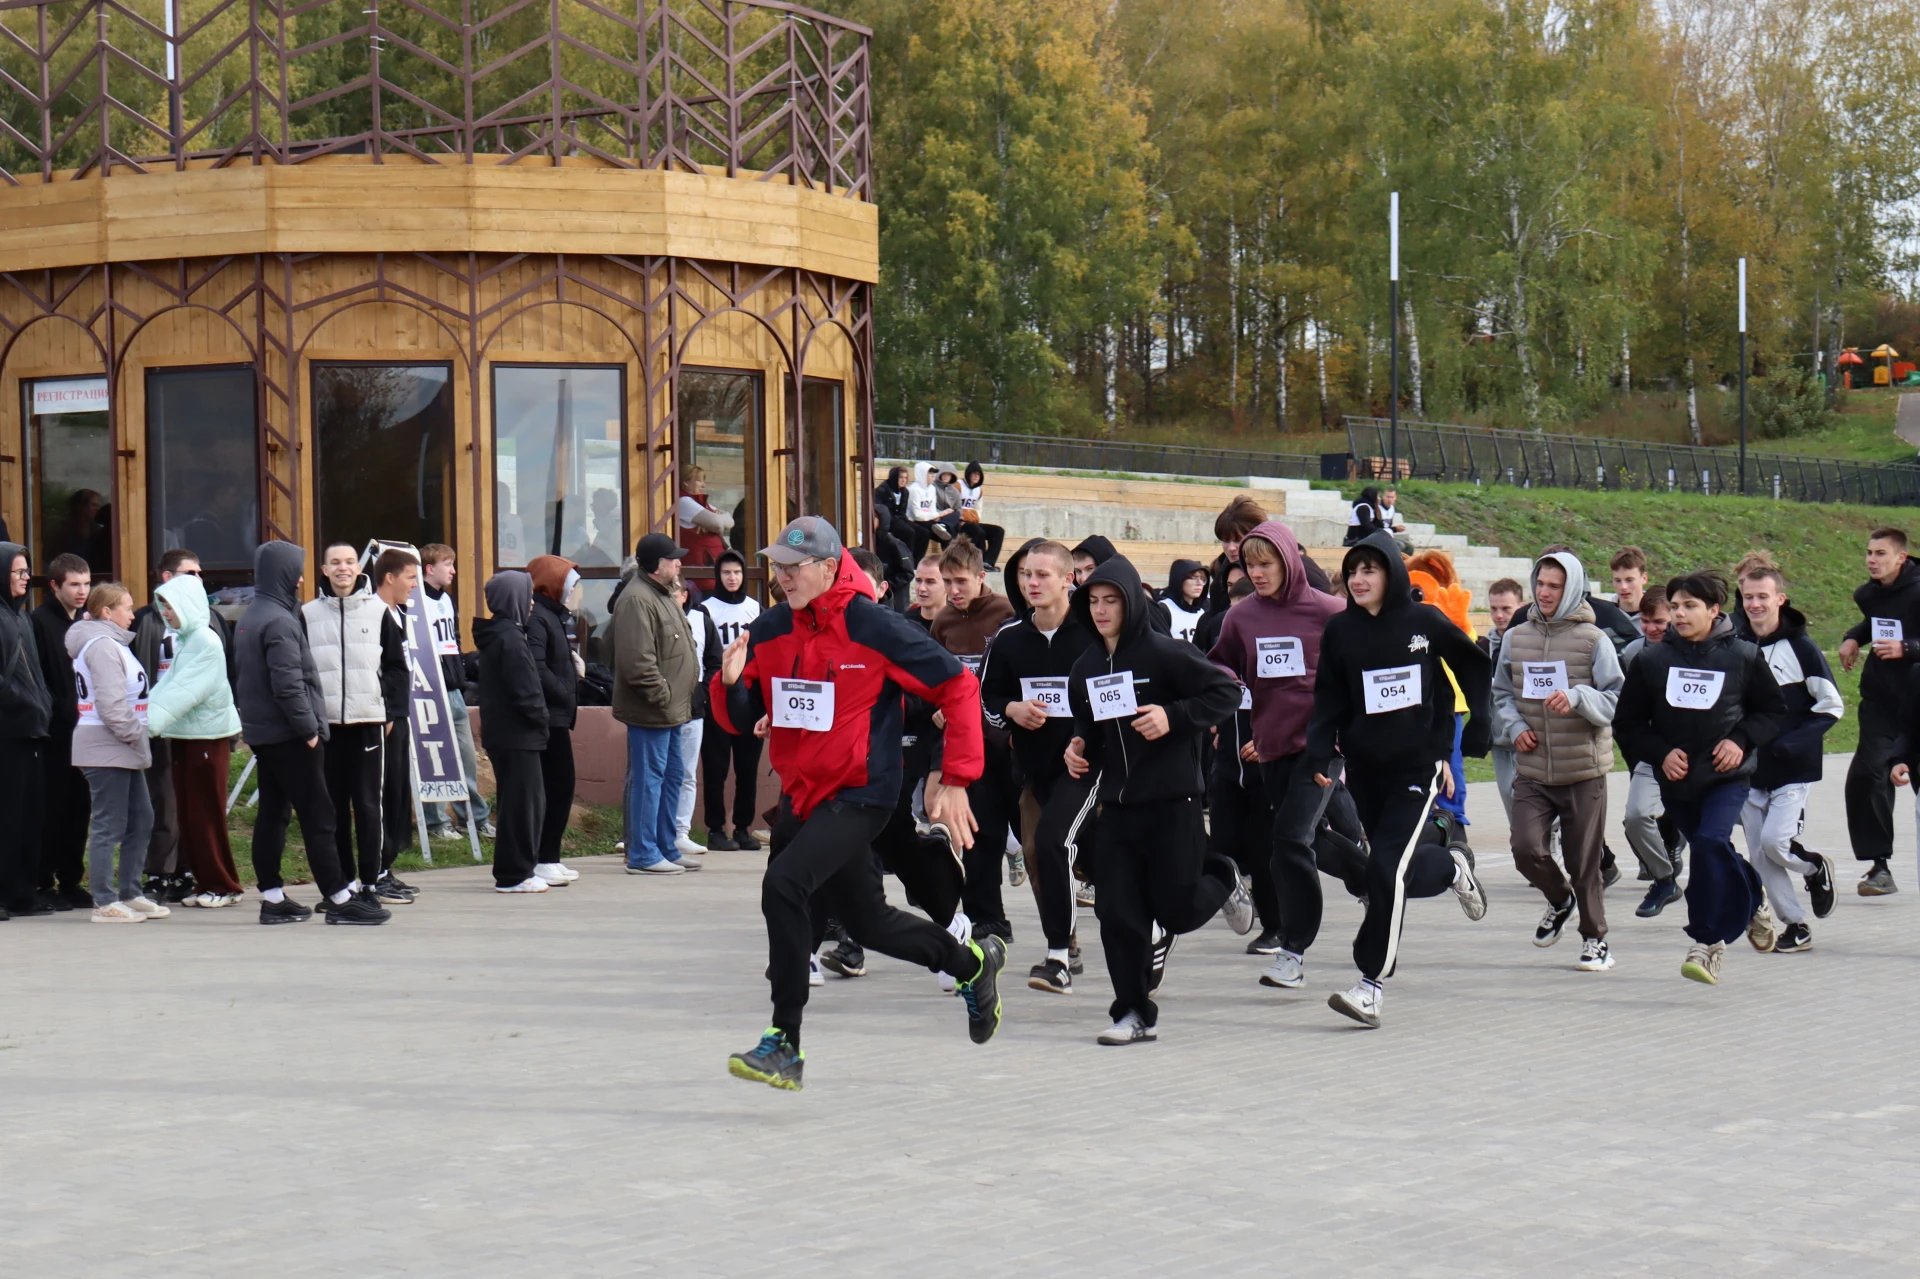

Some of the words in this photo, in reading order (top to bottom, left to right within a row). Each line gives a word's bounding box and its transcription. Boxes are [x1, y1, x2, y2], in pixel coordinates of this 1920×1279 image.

[433, 617, 455, 642] 170
[1880, 629, 1894, 637] 098
[1265, 653, 1289, 664] 067
[406, 599, 446, 776] ТАРТ
[1533, 678, 1553, 687] 056
[1682, 683, 1707, 694] 076
[1100, 689, 1121, 703] 065
[1380, 685, 1406, 698] 054
[788, 697, 815, 711] 053
[1037, 693, 1061, 704] 058
